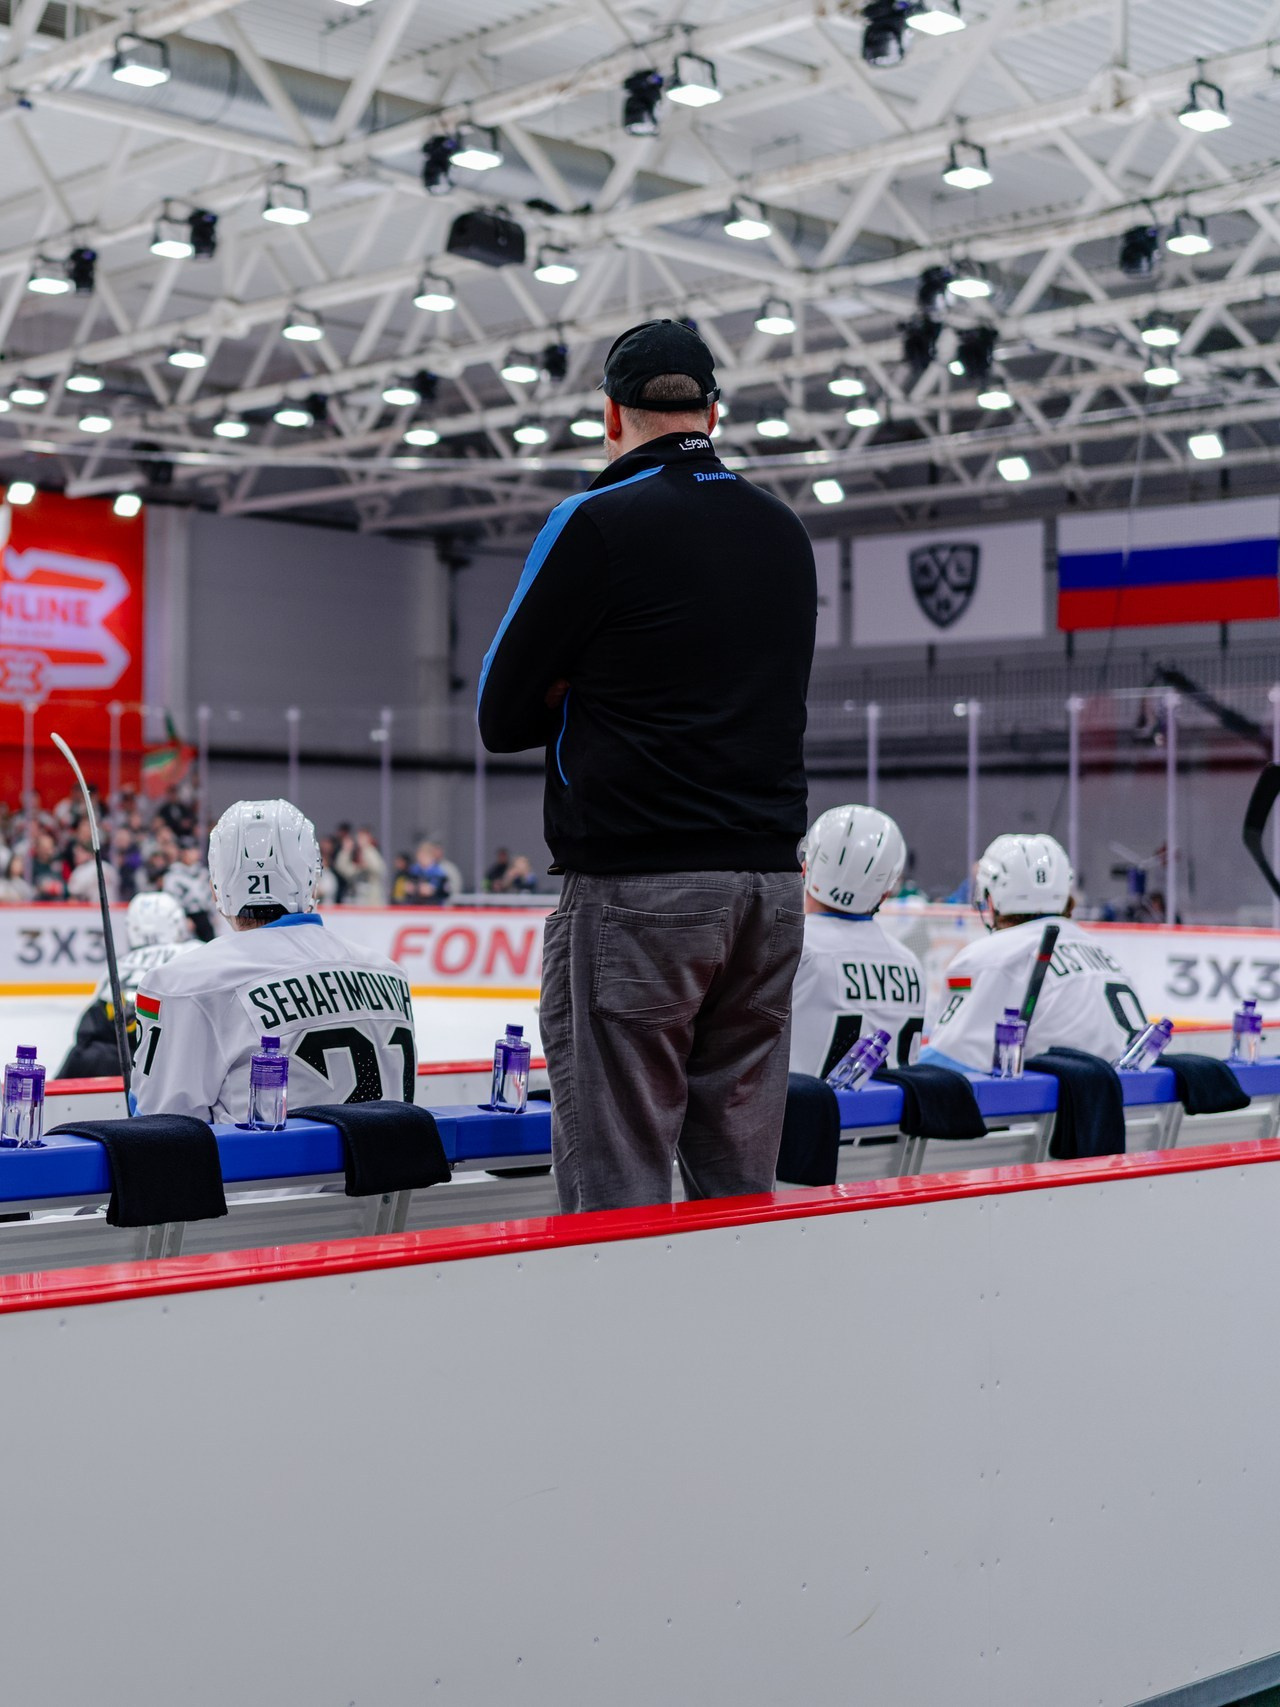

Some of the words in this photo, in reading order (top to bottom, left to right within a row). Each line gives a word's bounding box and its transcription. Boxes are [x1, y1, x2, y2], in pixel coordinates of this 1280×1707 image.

[0, 594, 91, 629] NLINE
[248, 875, 270, 895] 21
[829, 887, 854, 906] 48
[17, 926, 106, 965] 3X3
[390, 926, 543, 978] FON
[842, 962, 921, 1004] SLYSH
[1166, 955, 1280, 1002] 3X3
[294, 1026, 416, 1105] 21
